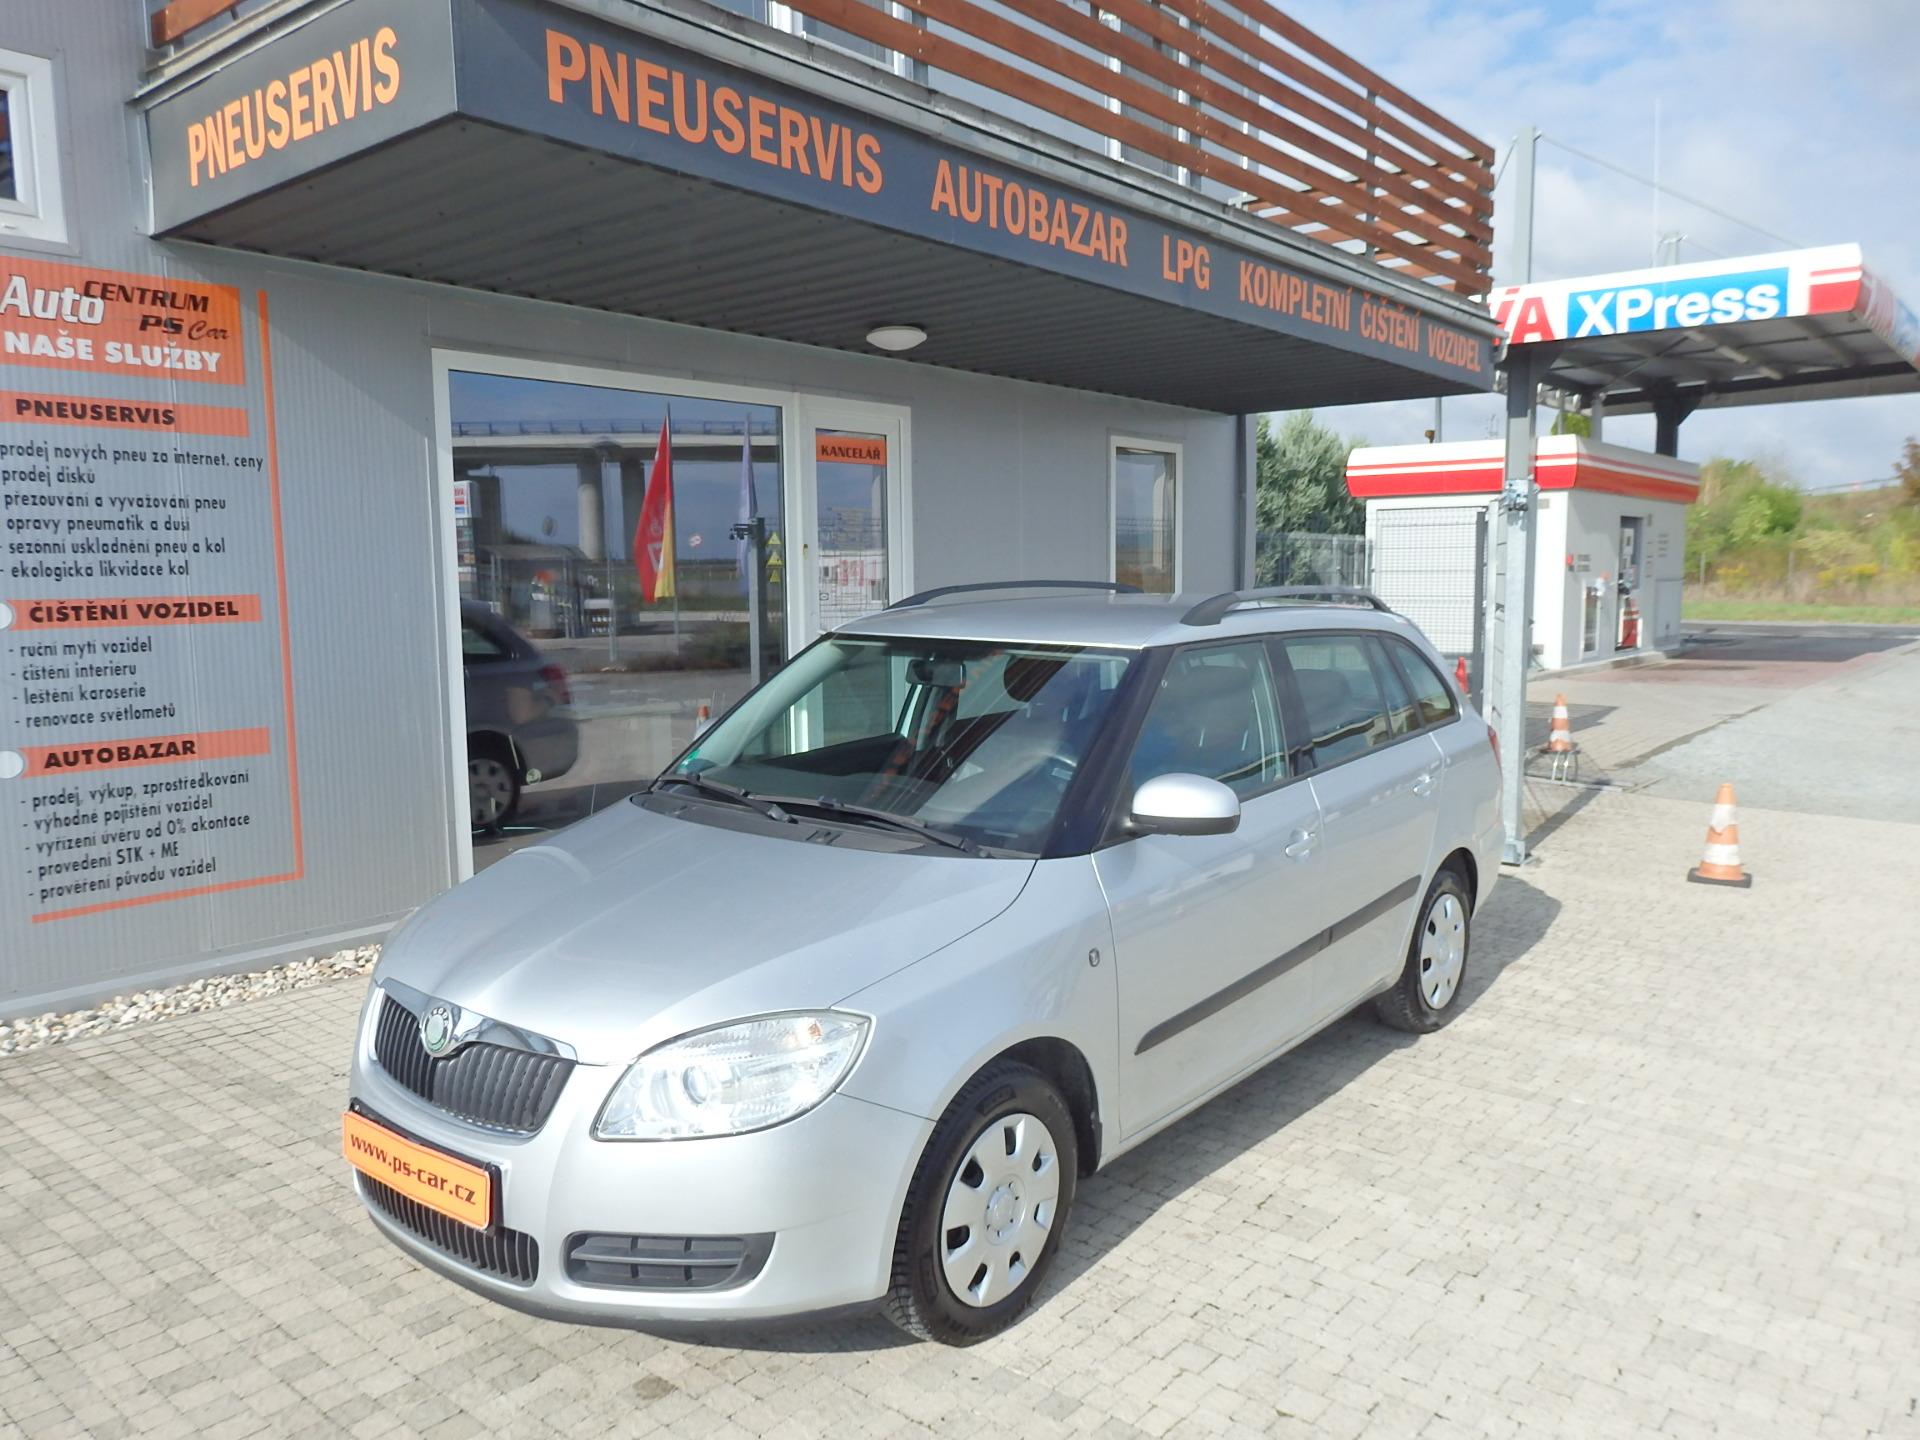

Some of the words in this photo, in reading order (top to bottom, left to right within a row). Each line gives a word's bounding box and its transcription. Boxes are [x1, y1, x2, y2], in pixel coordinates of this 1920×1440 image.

[187, 26, 400, 187] PNEUSERVIS
[545, 28, 883, 195] PNEUSERVIS
[931, 159, 1128, 267] AUTOBAZAR
[1163, 234, 1210, 291] LPG
[1239, 260, 1351, 331] KOMPLETNÍ
[1359, 292, 1421, 353] ČIŠTĚNÍ
[1428, 324, 1482, 373] VOZIDEL
[0, 274, 105, 325] Auto
[84, 280, 209, 313] CENTRUM
[1574, 283, 1780, 338] XPress
[139, 314, 185, 335] PS
[188, 320, 229, 341] Car
[4, 329, 94, 361] NAŠE
[105, 341, 221, 372] SLUŽBY
[16, 398, 176, 426] PNEUSERVIS
[0, 440, 49, 462] prodej
[54, 443, 107, 464] nových
[113, 449, 147, 464] pneu
[152, 451, 168, 463] za
[174, 447, 230, 466] internet.
[234, 456, 264, 472] ceny
[821, 444, 880, 460] KANCELÁŘ
[2, 465, 51, 487] prodej
[4, 491, 89, 510] přezouvání
[95, 496, 103, 507] a
[109, 494, 190, 512] vyvažování
[195, 498, 226, 512] pneu
[6, 518, 60, 534] opravy
[67, 514, 144, 534] pneumatik
[150, 520, 158, 531] a
[9, 539, 66, 554] sezónní
[71, 537, 150, 554] uskladnění
[155, 542, 188, 557] pneu
[192, 543, 200, 553] a
[205, 537, 226, 553] kol
[99, 560, 163, 577] likvidace
[168, 559, 189, 576] kol
[29, 600, 129, 623] ČIŠTĚNÍ
[136, 601, 239, 619] VOZIDEL
[20, 641, 58, 657] ruční
[101, 636, 152, 653] vozidel
[22, 664, 70, 681] čištění
[75, 660, 137, 678] interiéru
[24, 686, 74, 704] leštění
[79, 682, 147, 701] karoserie
[26, 712, 95, 728] renovace
[100, 702, 176, 723] světlometů
[44, 740, 196, 769] AUTOBAZAR
[143, 769, 249, 798] zprostředkování
[34, 810, 98, 834] výhodné
[104, 801, 161, 826] pojištění
[166, 793, 213, 813] vozidel
[36, 836, 97, 857] vyřízení
[101, 828, 141, 845] úvěru
[145, 821, 162, 838] od
[166, 817, 187, 835] 0%
[191, 814, 250, 832] akontace
[38, 852, 112, 881] provedení
[116, 846, 144, 865] STK
[161, 841, 179, 859] ME
[40, 874, 111, 903] prověření
[116, 865, 165, 891] původu
[170, 857, 216, 878] vozidel
[350, 1134, 477, 1206] www.ps-car.cz
